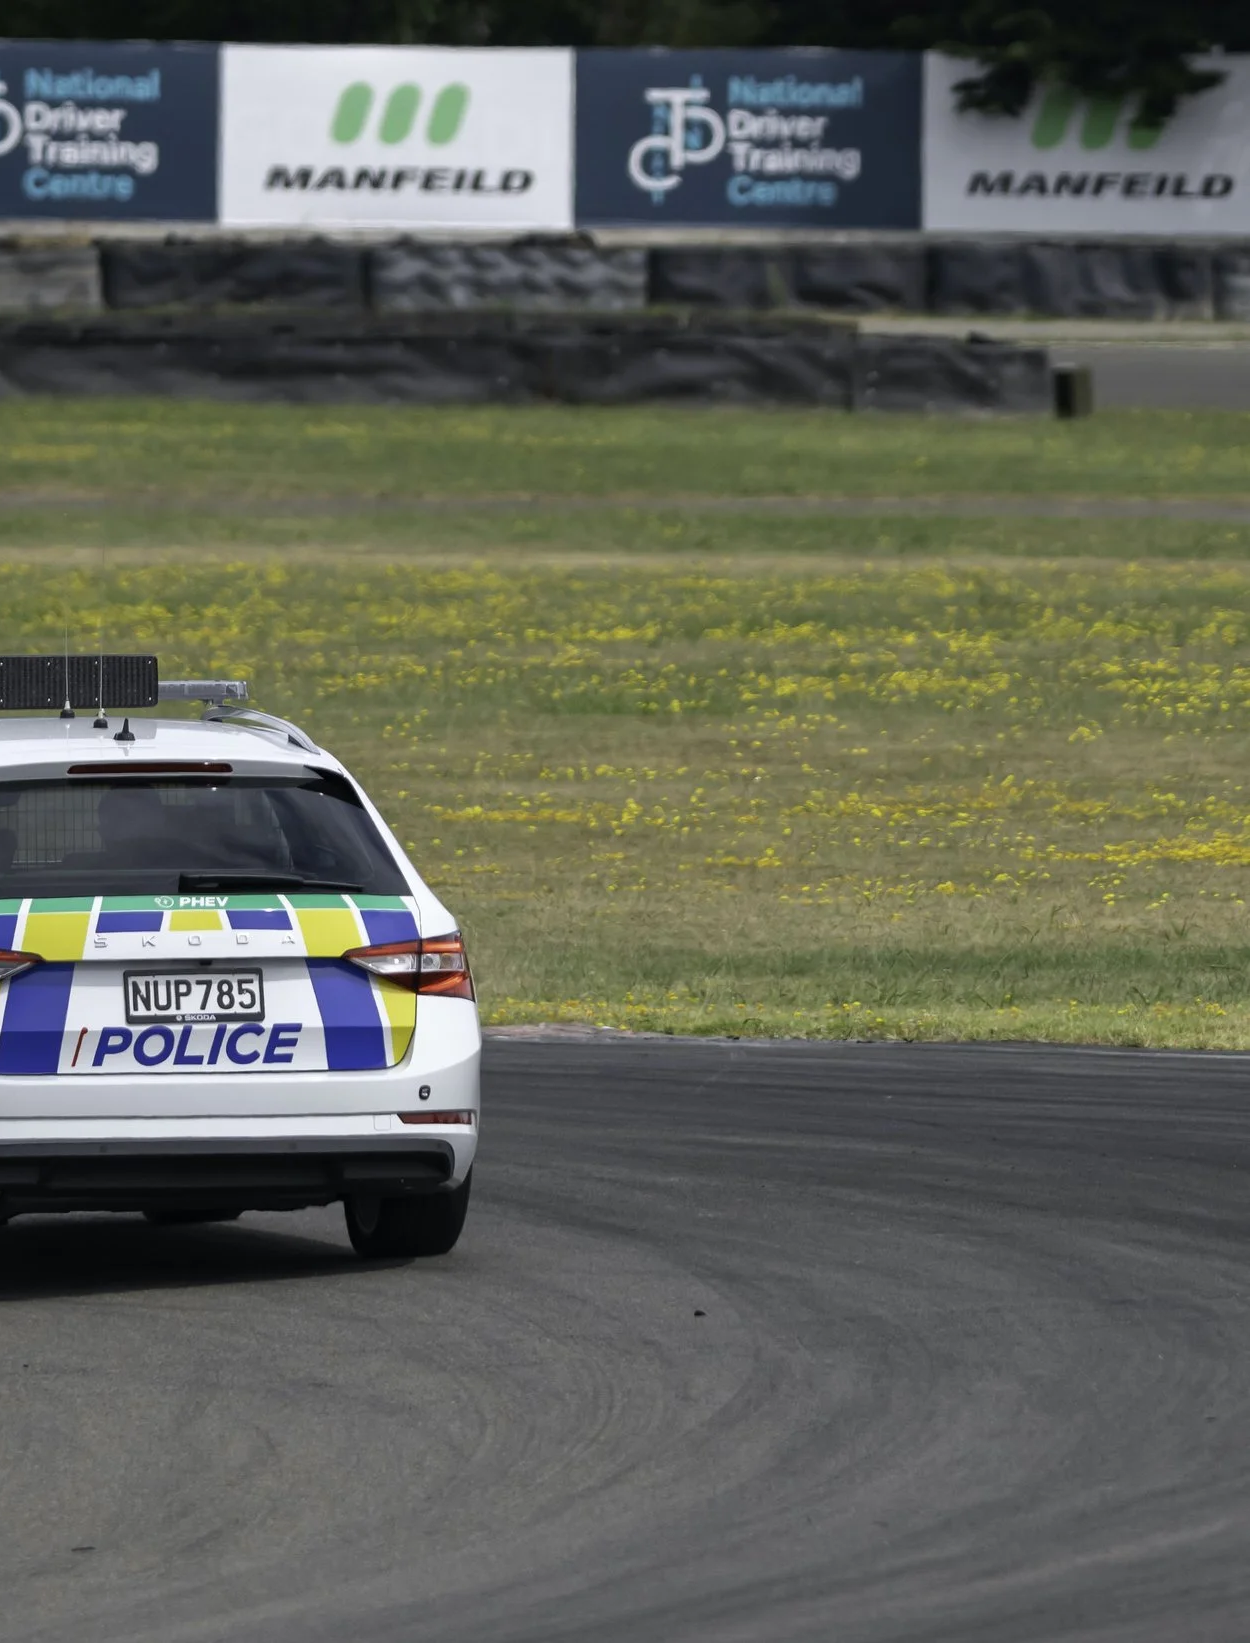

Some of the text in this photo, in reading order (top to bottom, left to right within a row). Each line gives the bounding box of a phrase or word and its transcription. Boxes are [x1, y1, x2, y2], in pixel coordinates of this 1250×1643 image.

[24, 67, 160, 101] National
[728, 75, 863, 108] National
[24, 101, 126, 133] Driver
[728, 108, 828, 140] Driver
[25, 133, 159, 175] Training
[728, 140, 861, 180] Training
[22, 167, 134, 201] Centre
[265, 163, 534, 194] MANFEILD
[727, 175, 837, 205] Centre
[967, 169, 1234, 198] MANFEILD
[179, 896, 228, 907] PHEV
[131, 978, 257, 1012] NUP785
[92, 1023, 303, 1067] POLICE
